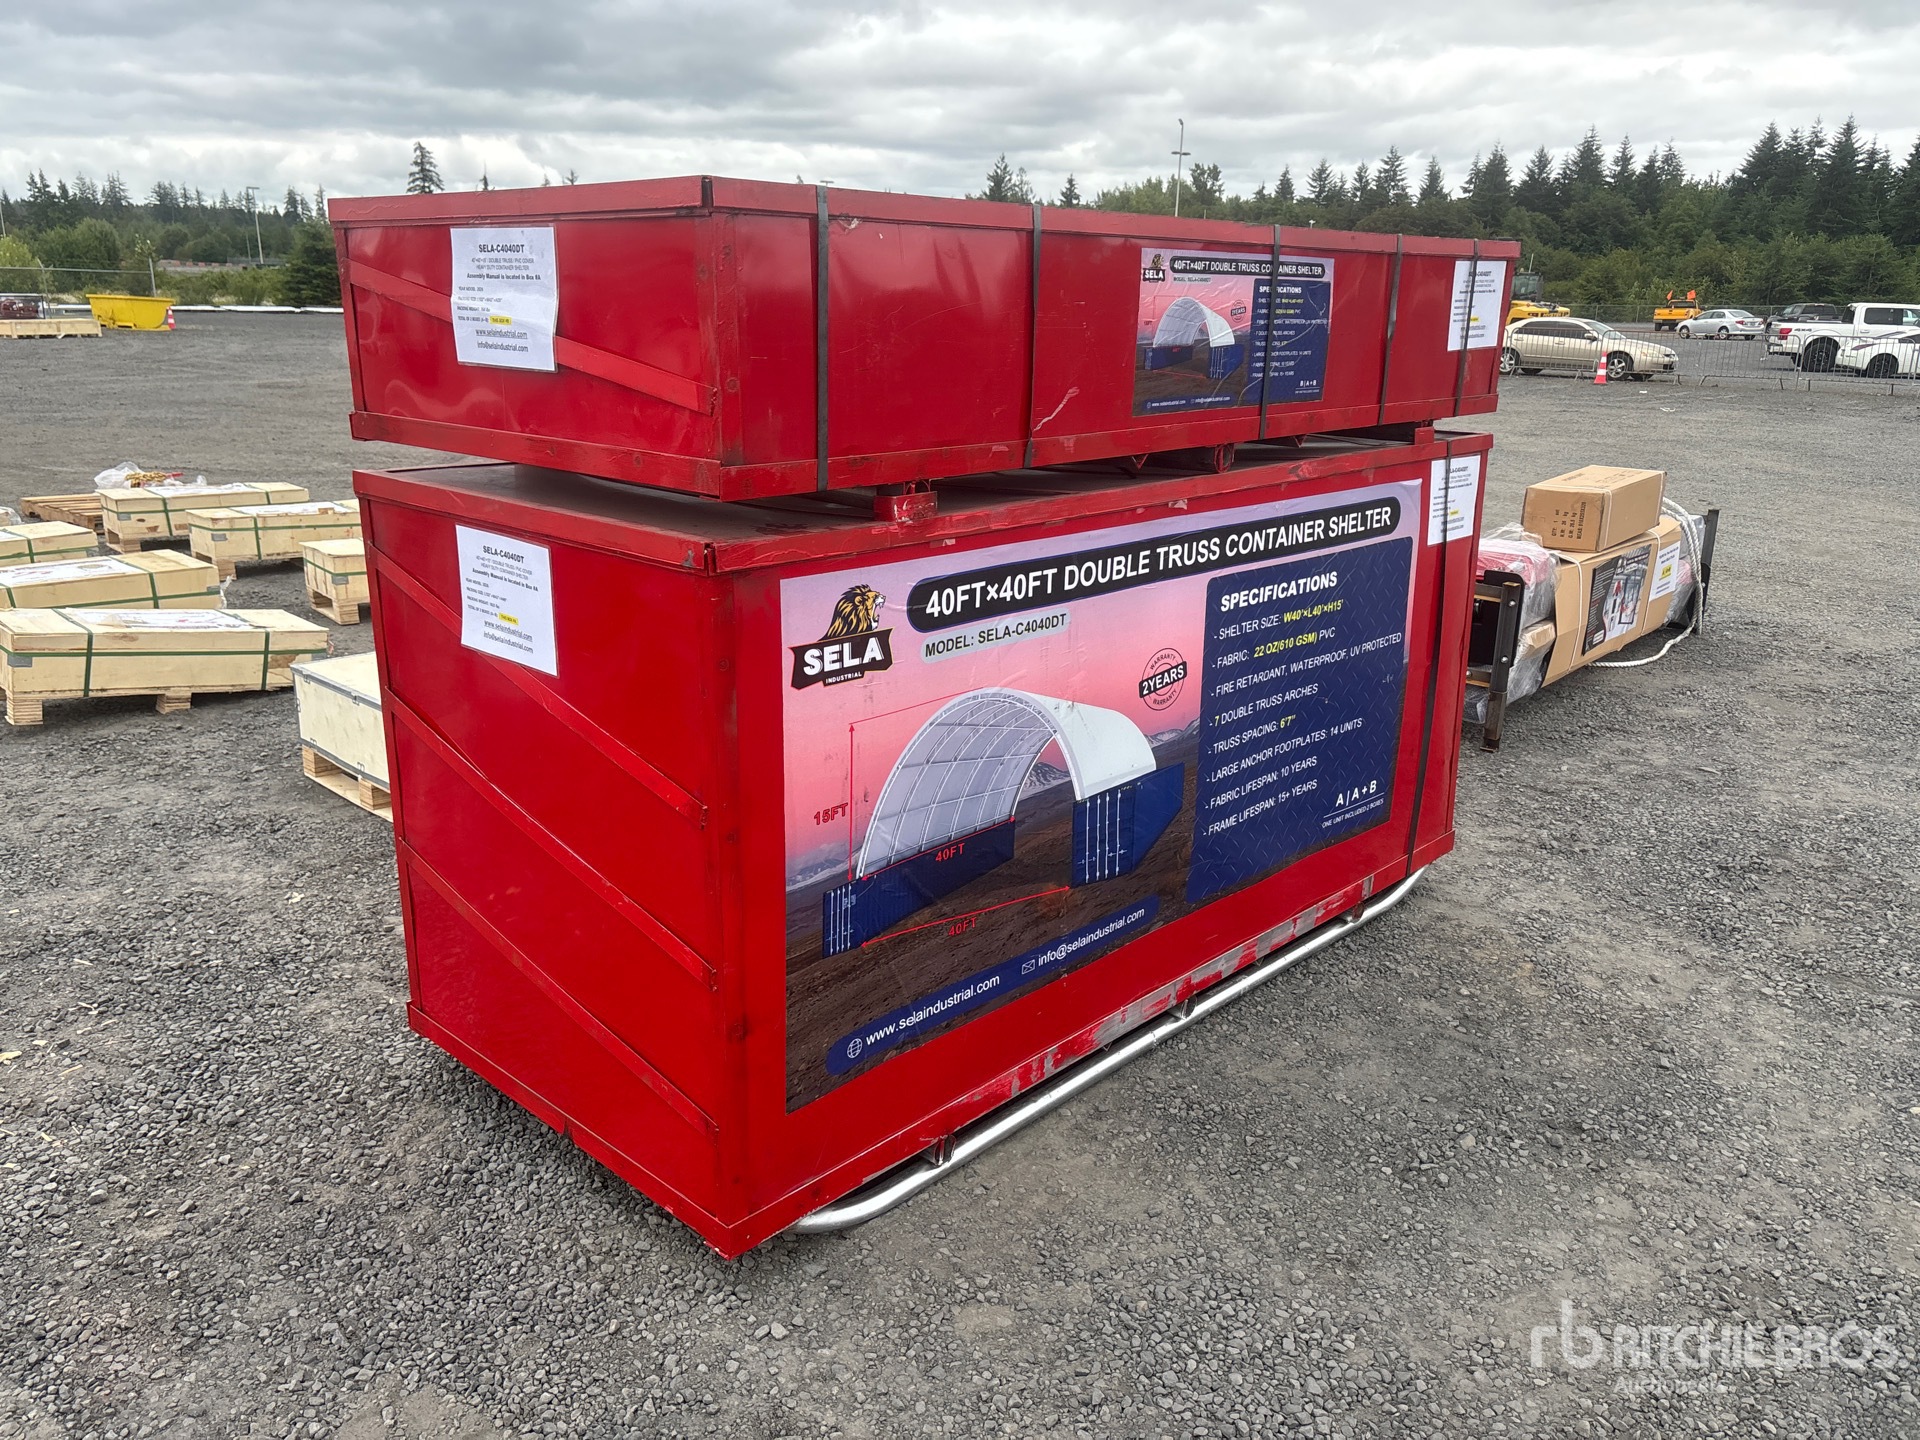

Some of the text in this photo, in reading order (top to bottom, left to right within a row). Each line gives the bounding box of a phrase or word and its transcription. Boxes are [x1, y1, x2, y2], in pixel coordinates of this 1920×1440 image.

[478, 244, 524, 253] SELA-C4040DT
[1144, 270, 1164, 278] SELA
[1210, 262, 1236, 272] DOUBLE
[1238, 263, 1260, 272] TRUSS
[1261, 264, 1297, 274] COAINER
[1298, 266, 1322, 274] SHELTER
[482, 545, 524, 564] SELA-C4040DT
[1064, 550, 1150, 590] DOUBLE
[1156, 538, 1220, 570] TRUSS
[1225, 518, 1324, 557] CONTAINER
[1328, 506, 1392, 538] SHELTER
[1220, 571, 1338, 612] SPECIFICATIONS
[925, 613, 1066, 658] MODEL: SELA-C4040DT
[1219, 620, 1259, 640] SHELTER
[1260, 614, 1281, 629] SIZE:
[804, 637, 884, 676] SELA
[1150, 653, 1176, 670] WARRANTY
[1217, 650, 1250, 668] FABRIC:
[1254, 646, 1264, 658] 22
[1296, 632, 1318, 646] GSM)
[1318, 627, 1336, 640] PVC
[826, 672, 862, 684] INDUSTRIAL
[1142, 664, 1184, 695] 2YEARS
[1216, 632, 1402, 698] FIRE RETARDANT, WATERPROOF, UV PROTECTED
[1153, 689, 1177, 705] WARRANTY
[1214, 684, 1318, 727] 7 DOUBLE TRUSS ARCHES
[1212, 718, 1362, 782] LARGE ANCHOR FOOTPLATES: 14 UNITS
[1213, 736, 1240, 754] TRUSS
[1242, 722, 1279, 743] SPACING:
[1210, 756, 1318, 810] FABRIC LIFESPAN: 10 YEARS
[814, 803, 848, 826] 15FT
[1208, 779, 1318, 836] FRAME LIFESPAN: 15+ YEARS
[1322, 820, 1332, 828] ONE
[1334, 814, 1344, 825] UNIT
[1344, 806, 1366, 820] INCLUDED
[1370, 798, 1384, 810] BOXES
[936, 843, 966, 862] 40FT
[948, 917, 977, 936] 40FT
[866, 907, 1145, 1046] www.selaindustrial.com info@selaindustrial.com
